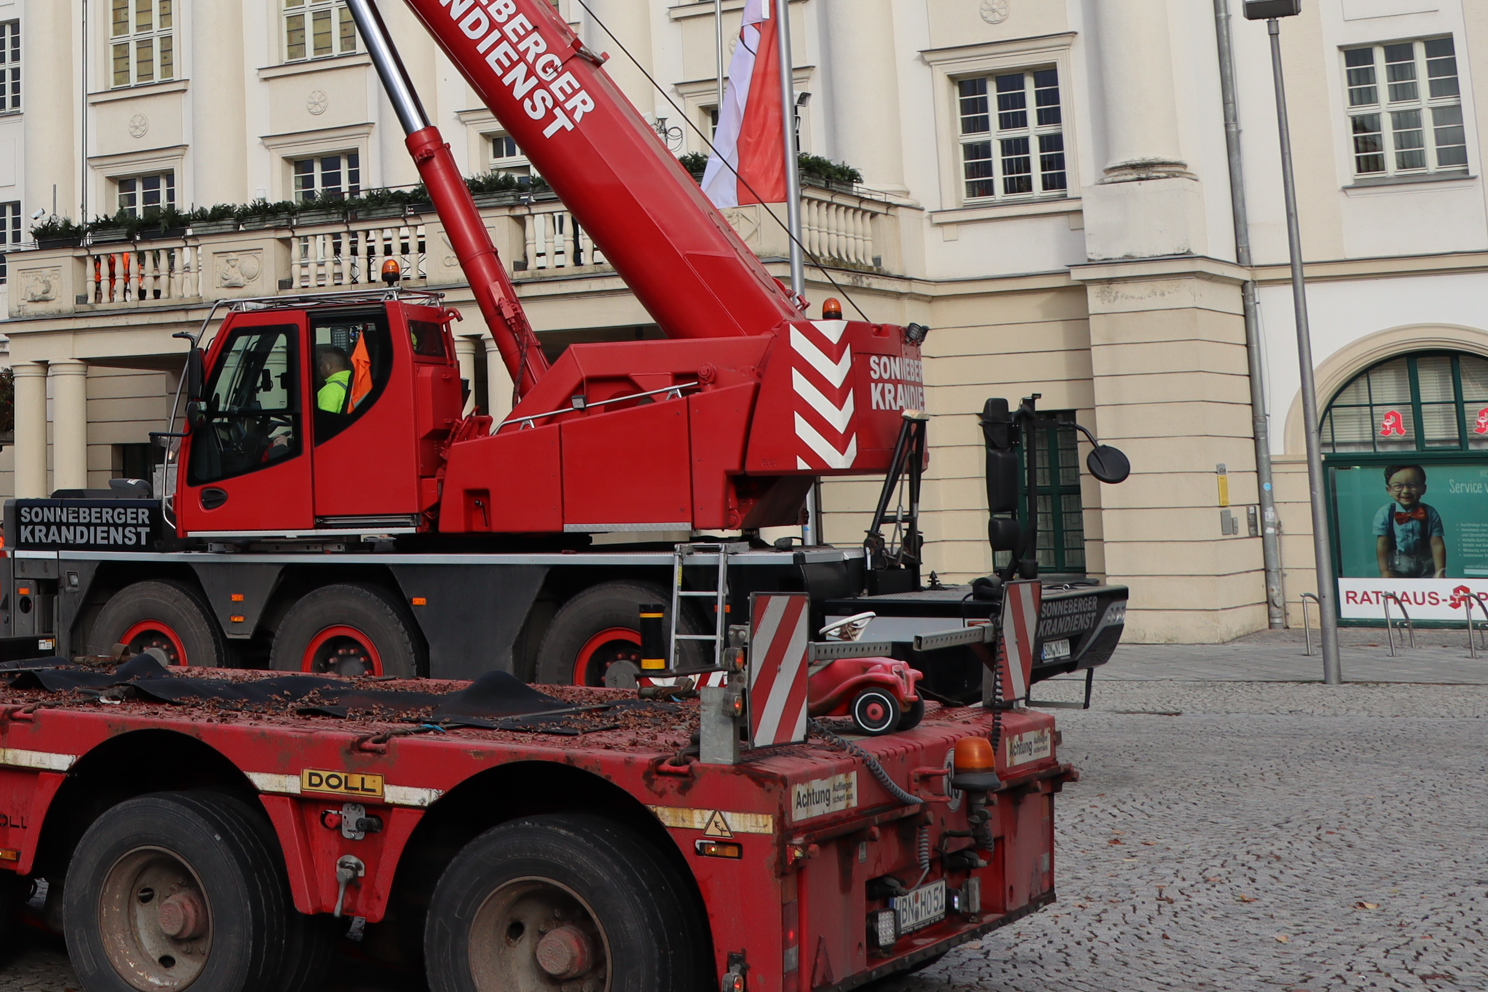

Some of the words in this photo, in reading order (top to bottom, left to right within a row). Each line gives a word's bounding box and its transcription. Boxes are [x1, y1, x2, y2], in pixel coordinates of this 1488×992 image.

[1449, 478, 1483, 494] Service
[20, 507, 151, 524] SONNEBERGER
[20, 525, 151, 545] KRANDIENST
[1041, 596, 1098, 619] SONNEBERGER
[1037, 612, 1097, 638] KRANDIENST
[308, 771, 377, 793] DOLL
[796, 788, 831, 810] Achtung
